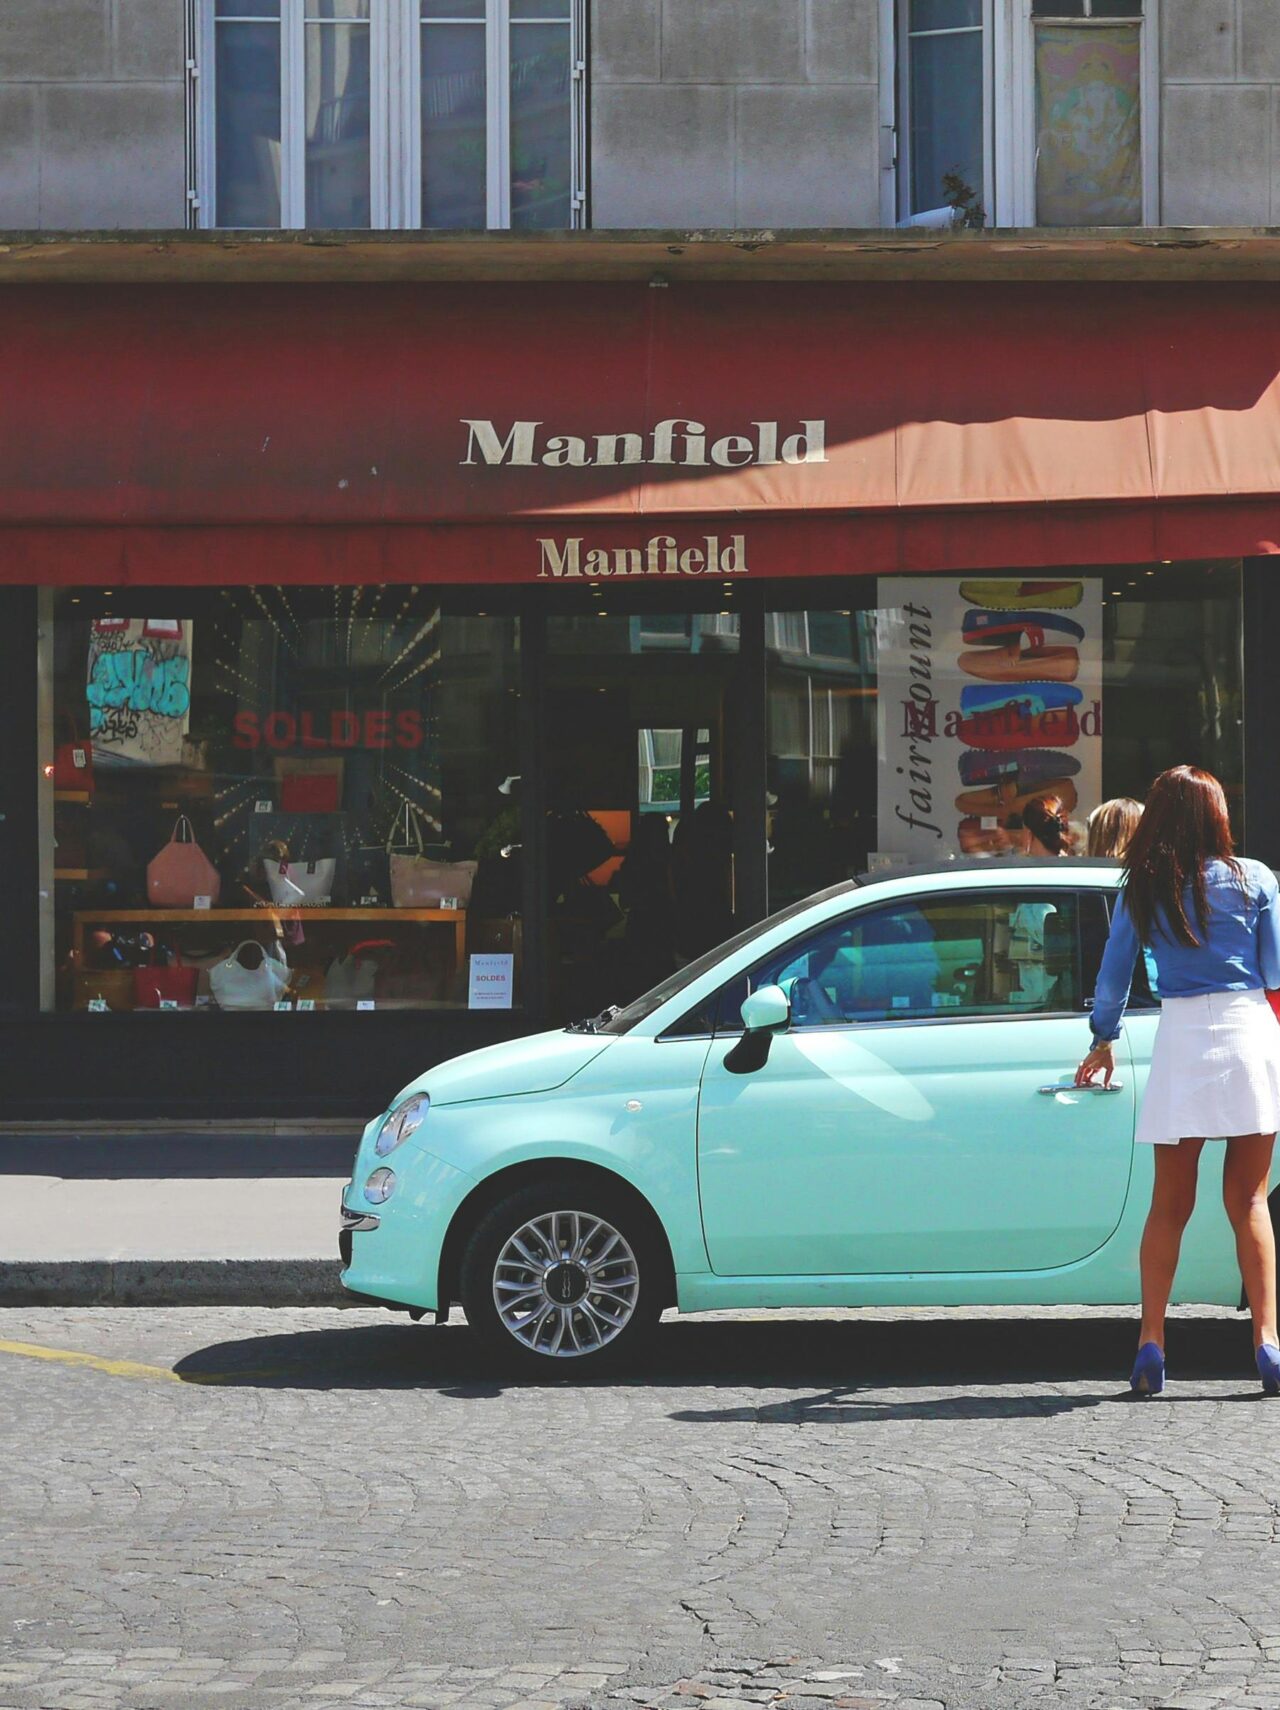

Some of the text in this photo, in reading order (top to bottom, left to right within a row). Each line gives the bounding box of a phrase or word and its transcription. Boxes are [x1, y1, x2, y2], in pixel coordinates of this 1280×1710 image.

[459, 418, 829, 467] Manfield
[536, 534, 748, 578] Manfield
[232, 709, 425, 750] SOLDES
[896, 601, 943, 839] fairmount
[900, 698, 1102, 738] Manfield
